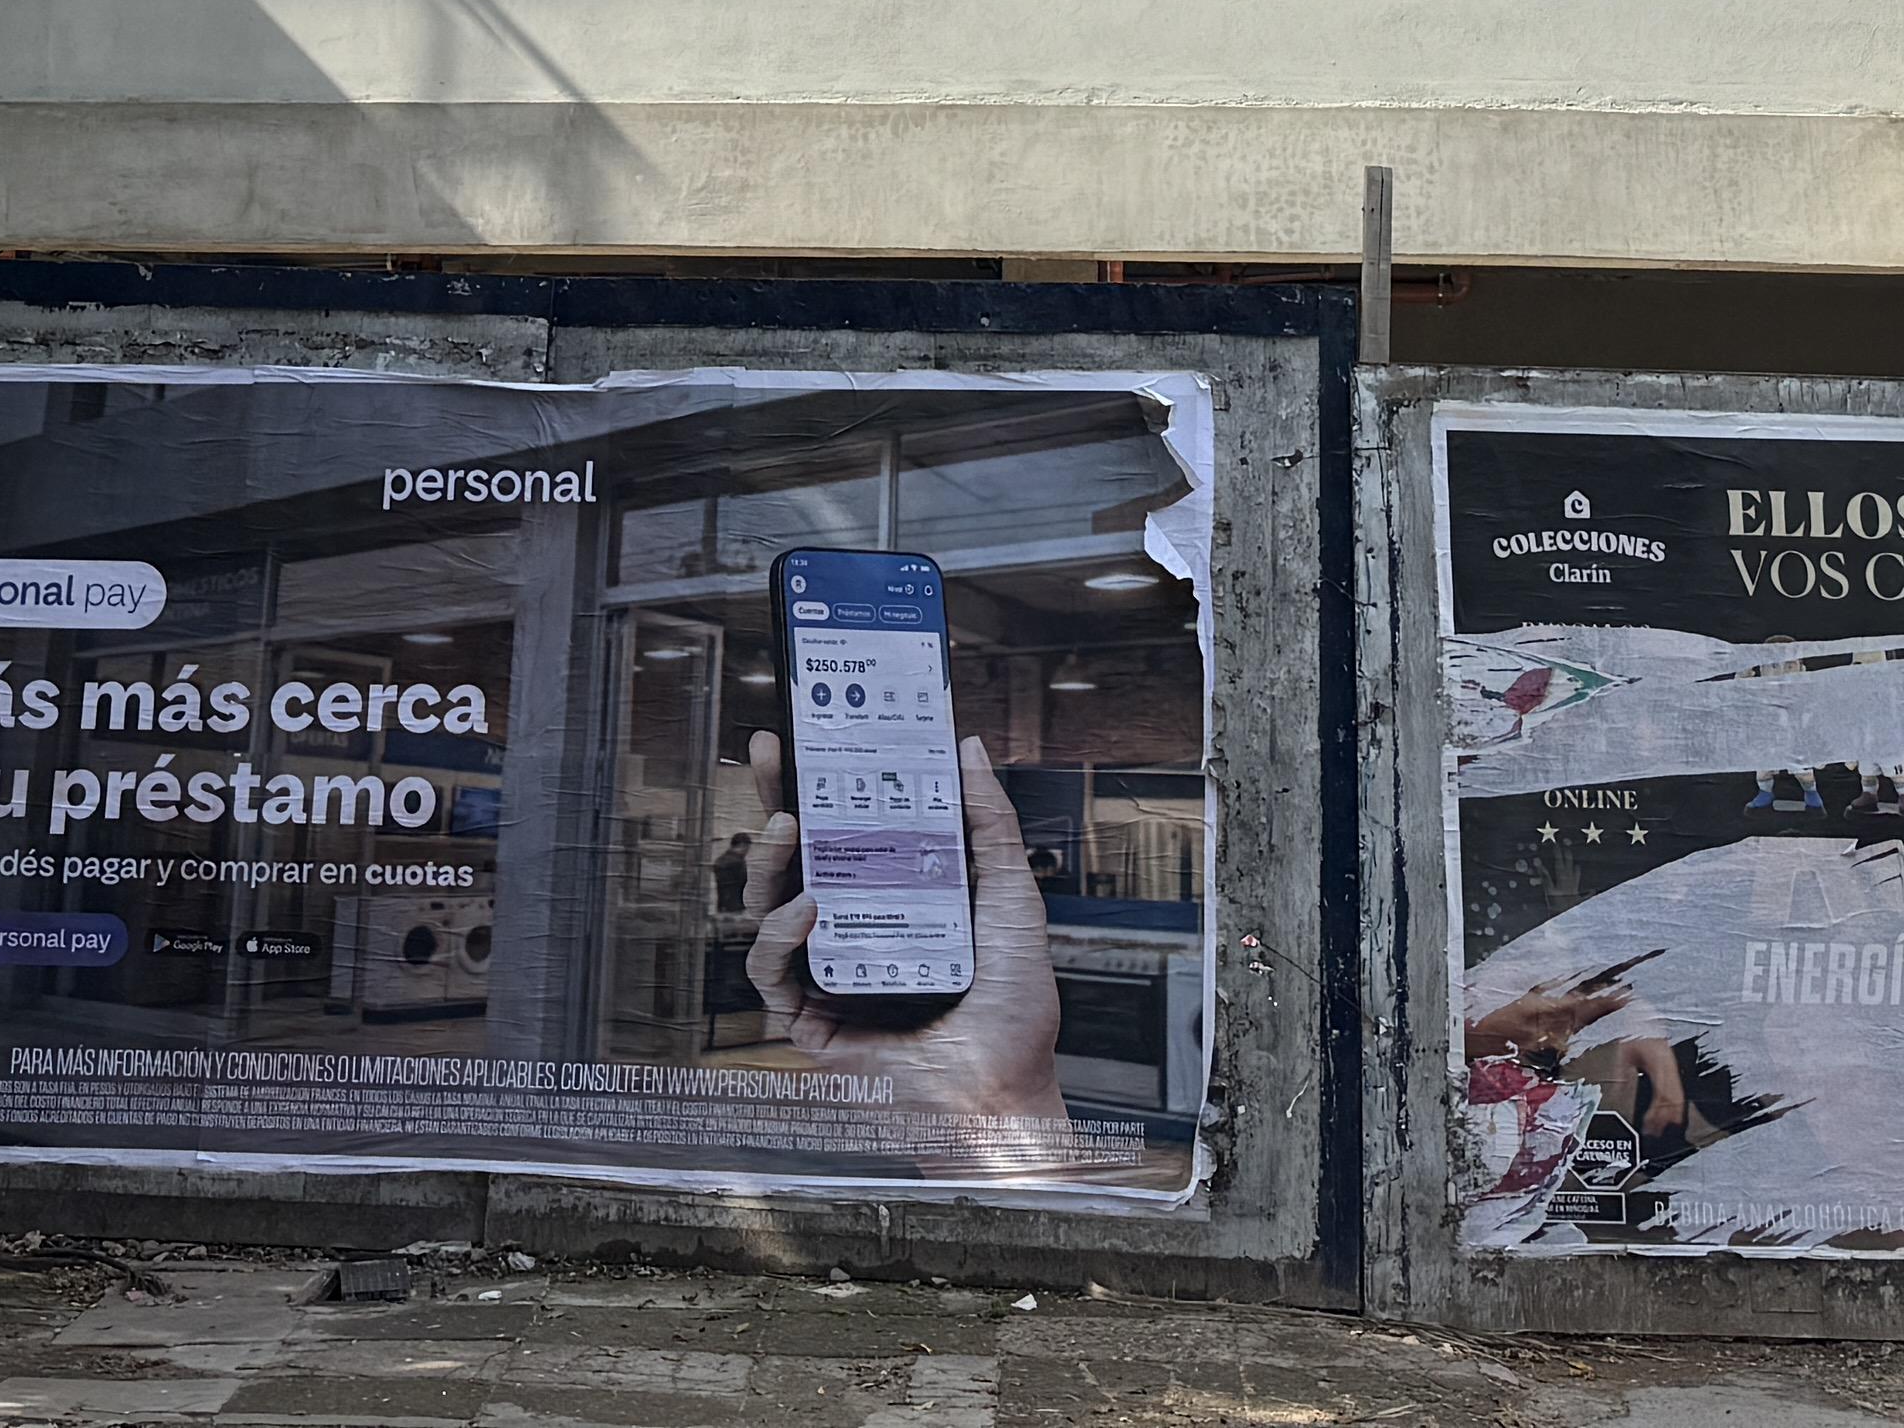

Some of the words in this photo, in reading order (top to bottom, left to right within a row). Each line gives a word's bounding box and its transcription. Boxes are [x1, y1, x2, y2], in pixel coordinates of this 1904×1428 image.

[382, 460, 597, 511] personal
[1493, 530, 1667, 563] COLECCIONES
[1548, 562, 1612, 584] Clarín
[1729, 547, 1851, 600] VOS
[84, 579, 148, 616] pay
[80, 664, 252, 733] más
[269, 680, 489, 735] cerca
[48, 753, 437, 835] préstamo
[1543, 789, 1639, 811] ONLINE
[61, 853, 151, 886] pagar
[155, 858, 175, 887] y
[179, 858, 313, 889] comprar
[318, 862, 357, 884] en
[364, 859, 474, 888] cuotas
[71, 930, 112, 954] pay
[261, 943, 283, 955] App
[284, 943, 311, 954] Store
[10, 1047, 54, 1075] PARA
[56, 1044, 96, 1076] MÁS
[97, 1046, 211, 1079] INFORMACIÓN
[213, 1051, 226, 1079] Y
[227, 1051, 335, 1082] CONDICIONES
[338, 1055, 348, 1082] O
[351, 1055, 460, 1086] LIMITACIONES
[462, 1058, 558, 1092] APLICABLES,
[560, 1062, 641, 1093] CONSULTE
[643, 1066, 664, 1094] EN
[667, 1066, 894, 1105] WWW.PERSONALPAY.COM.AR
[1583, 1139, 1615, 1150] CESO
[1616, 1140, 1632, 1150] EN
[1653, 1199, 1727, 1228] BEBIDA
[1734, 1201, 1892, 1232] ANALCOHÓLICA
